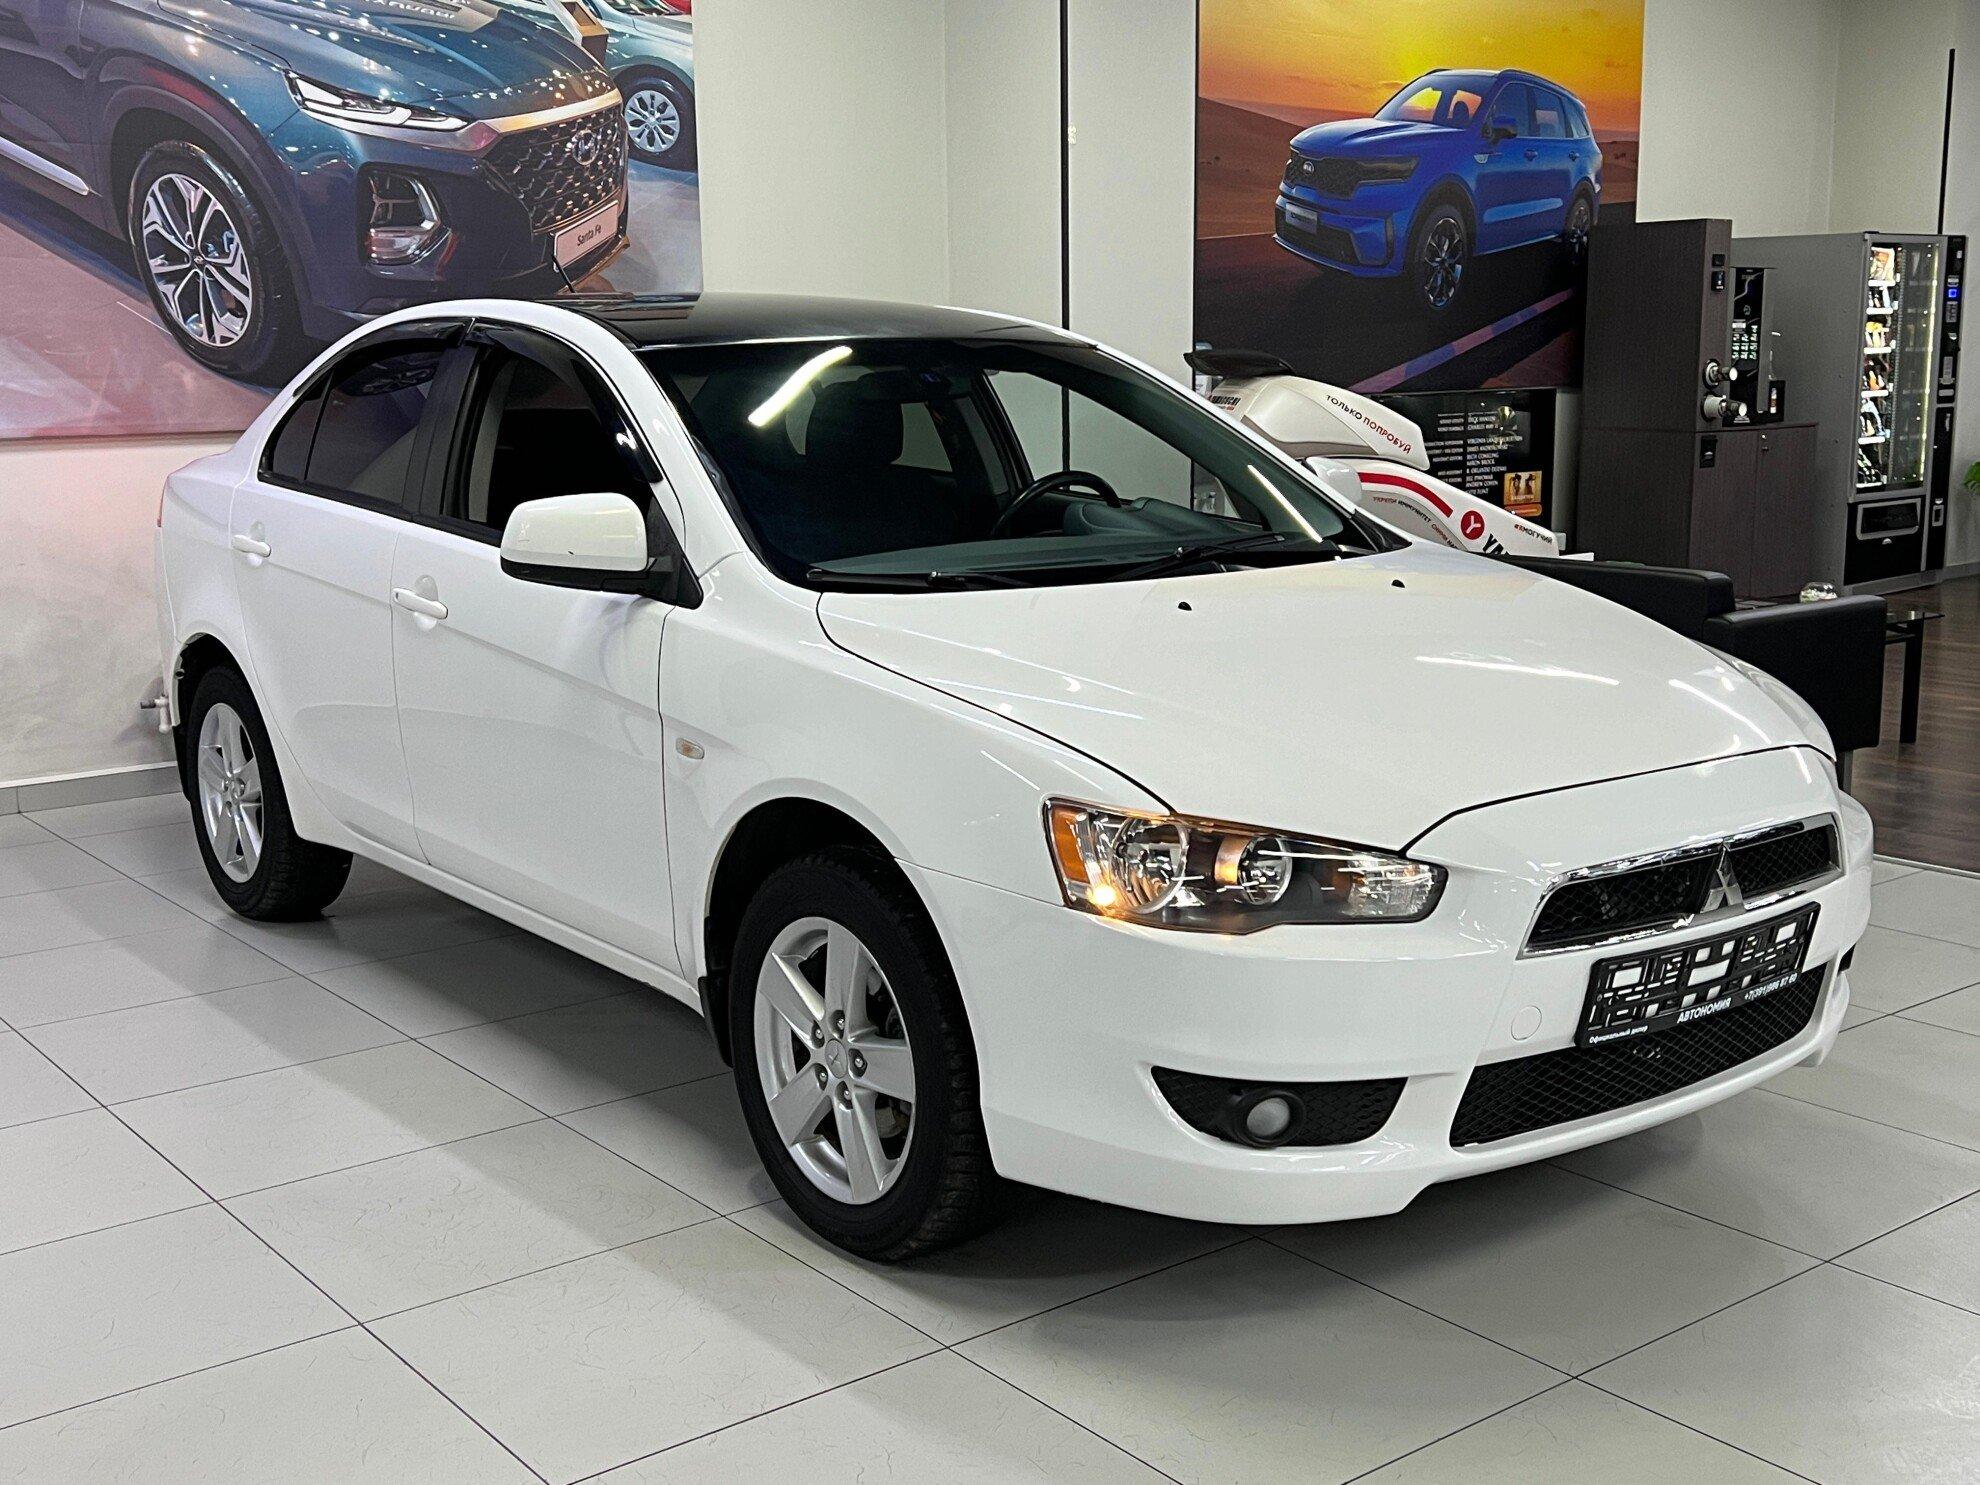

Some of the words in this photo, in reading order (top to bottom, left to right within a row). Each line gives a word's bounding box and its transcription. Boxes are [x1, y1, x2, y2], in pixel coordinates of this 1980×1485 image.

[577, 229, 594, 247] Santa
[1326, 395, 1362, 420] ТОЛЬКО
[1363, 416, 1412, 454] ПОПРОБУЙ
[1677, 997, 1732, 1024] АВТОНОМИЯ
